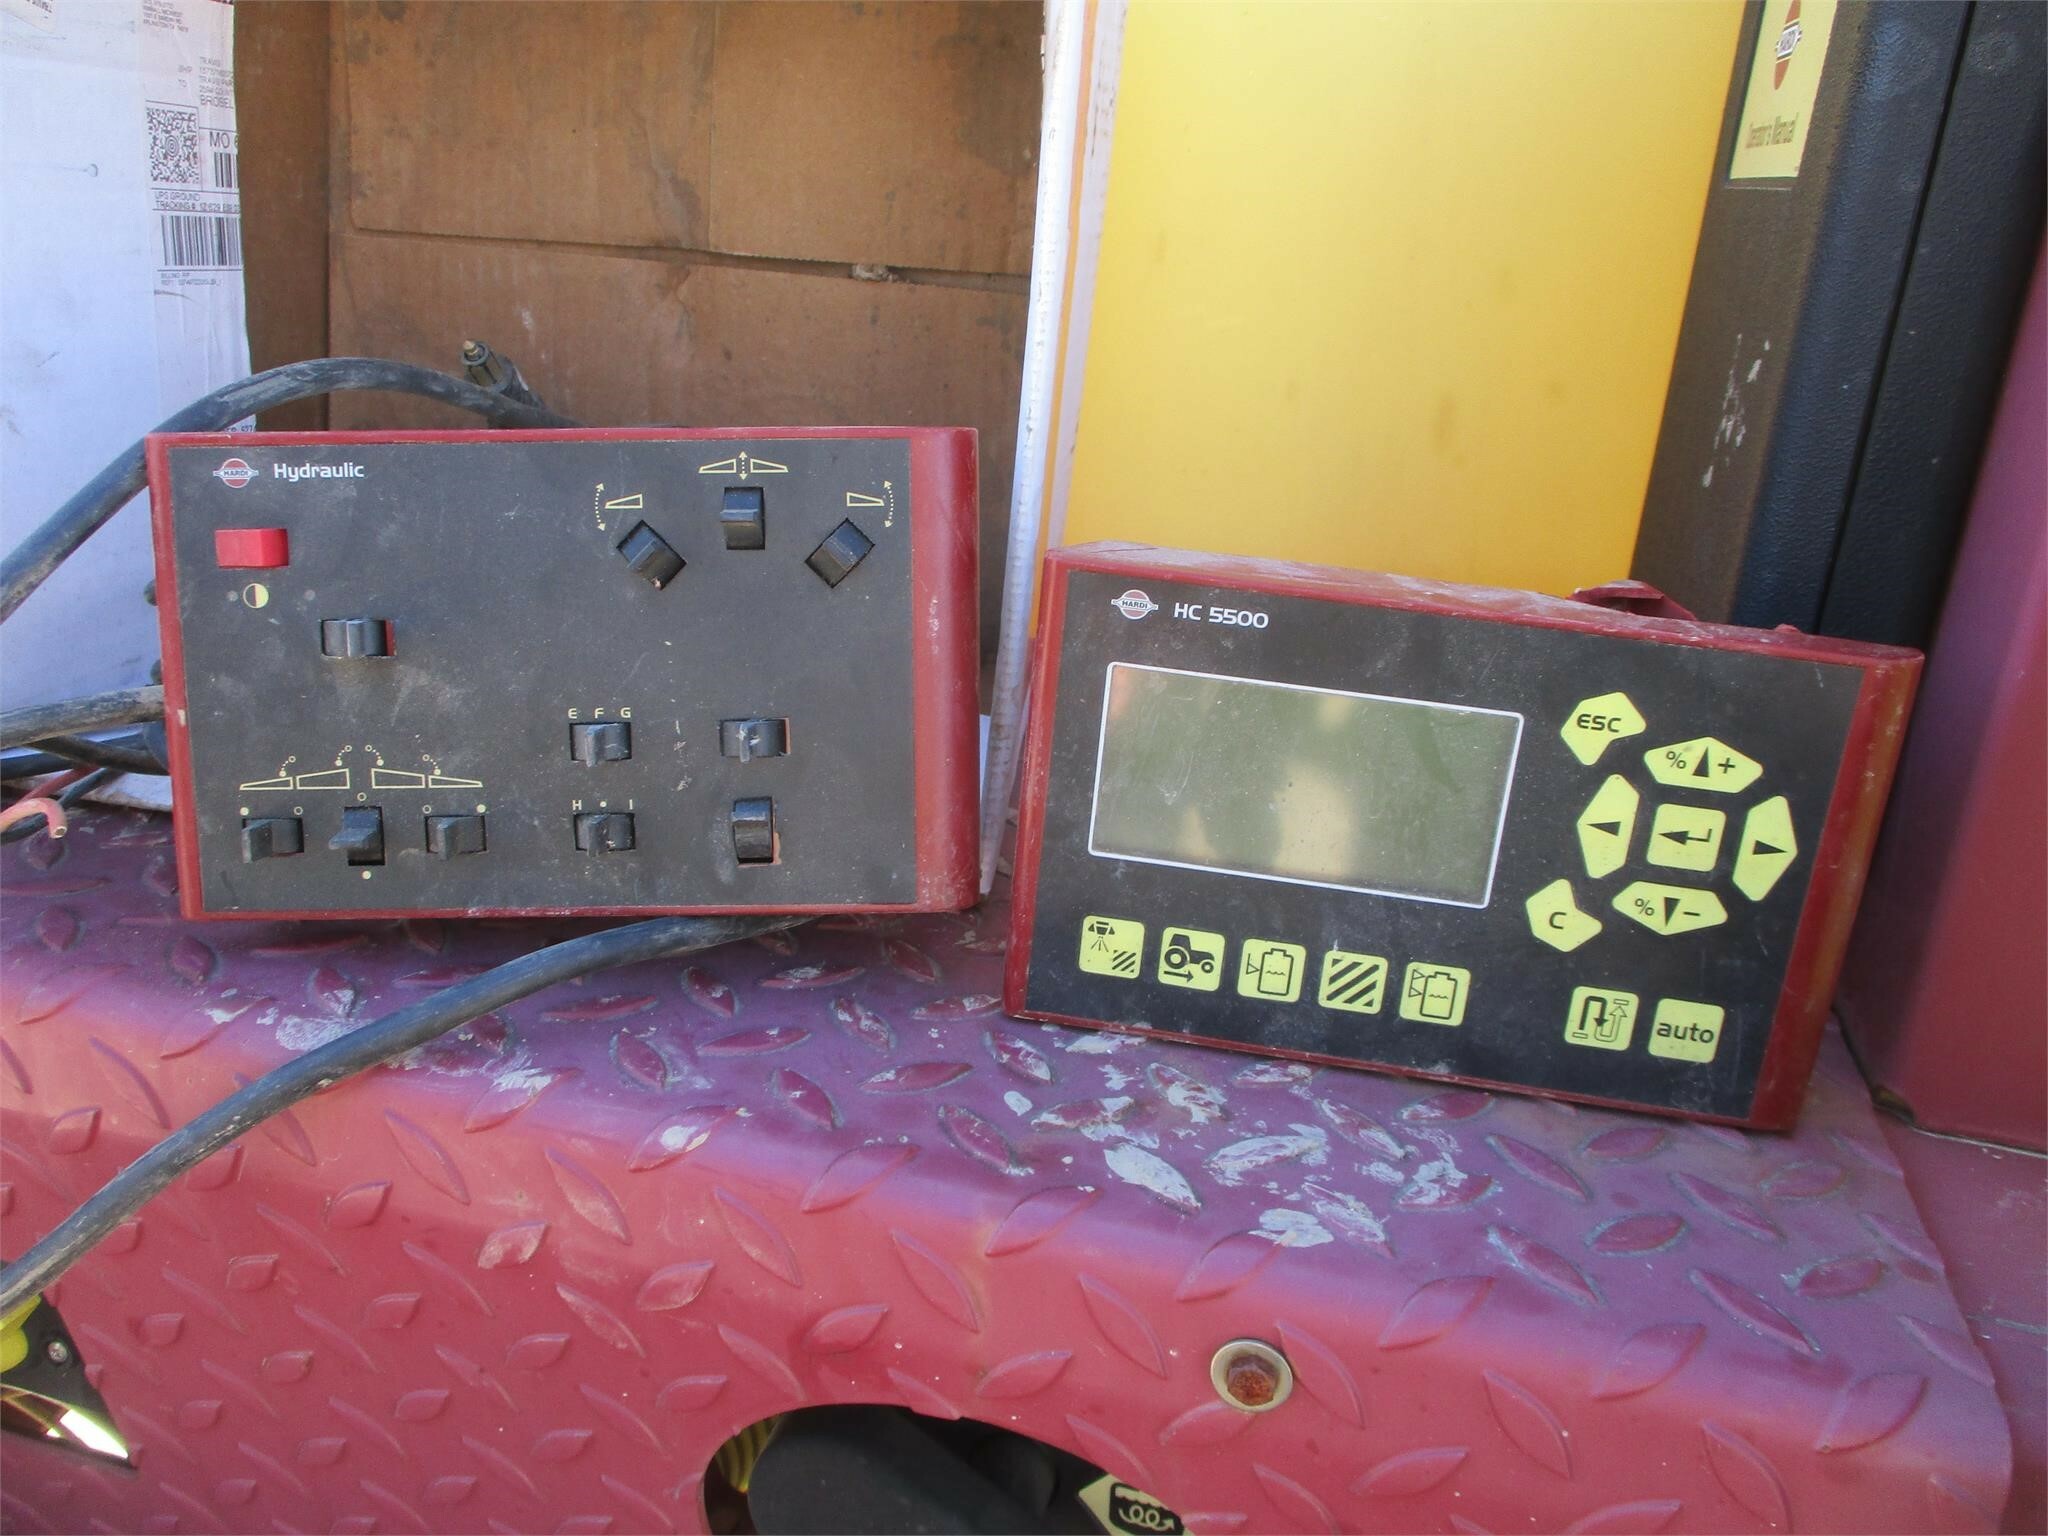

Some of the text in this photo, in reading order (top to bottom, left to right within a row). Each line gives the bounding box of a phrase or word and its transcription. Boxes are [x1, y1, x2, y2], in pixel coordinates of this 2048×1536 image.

[209, 131, 230, 149] MO
[155, 191, 199, 201] UPS GROUND
[156, 200, 190, 211] TRACKING
[273, 462, 365, 482] Hydraulic
[1121, 600, 1269, 629] HARDI HC 5500
[568, 707, 631, 719] E F G
[1576, 713, 1622, 733] ESC
[572, 800, 582, 811] H
[1549, 911, 1567, 930] C
[1656, 1022, 1715, 1044] auto
